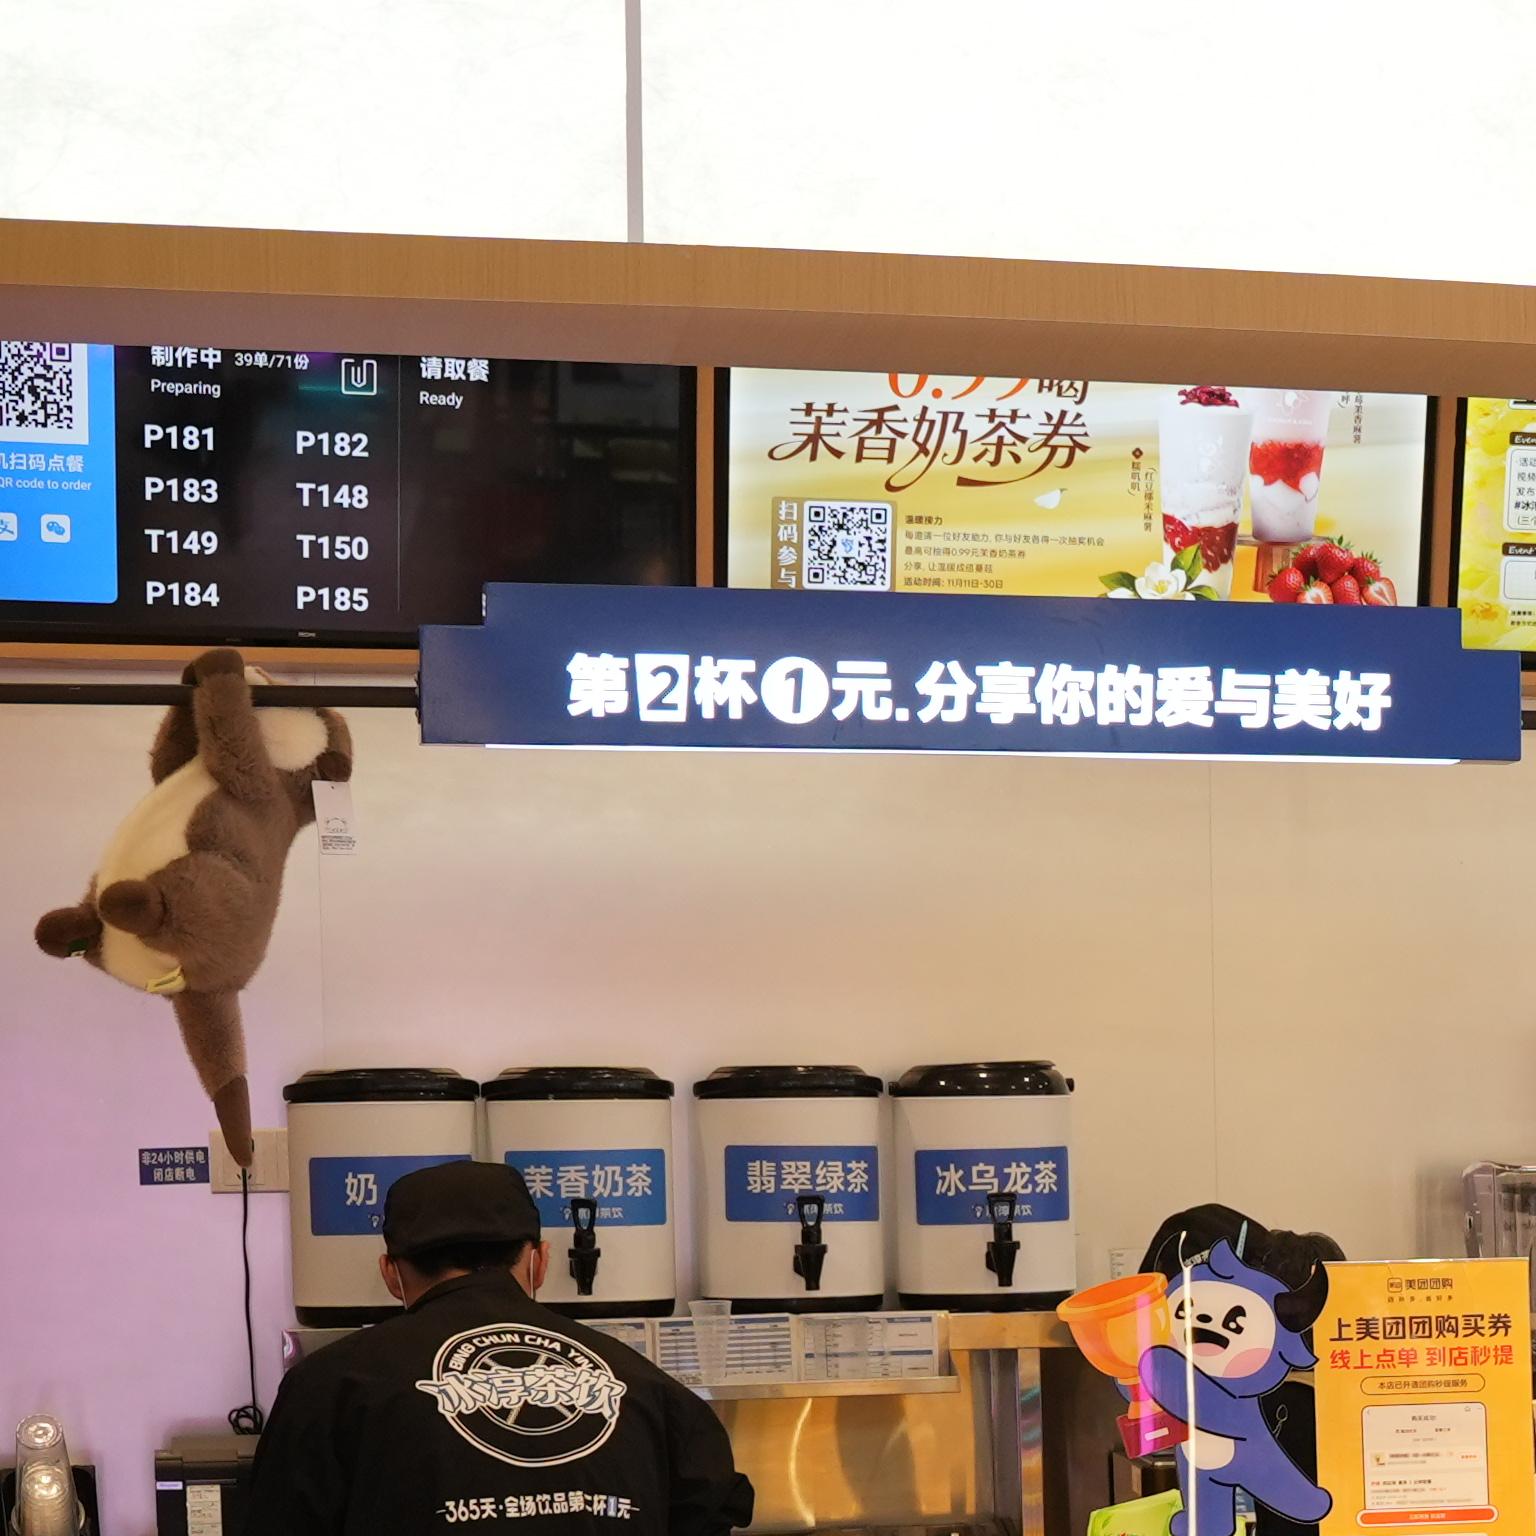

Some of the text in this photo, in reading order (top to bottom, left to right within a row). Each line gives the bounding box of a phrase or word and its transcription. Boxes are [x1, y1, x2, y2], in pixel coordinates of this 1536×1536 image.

[151, 346, 310, 370] 制作中 39单/71份
[420, 357, 489, 382] 请取餐
[150, 379, 221, 398] Preparing
[419, 391, 463, 409] Ready
[143, 424, 215, 451] P181
[296, 431, 369, 458] P182
[767, 402, 1091, 492] 茉香奶茶券
[16, 478, 44, 489] code
[47, 480, 58, 490] to
[62, 481, 91, 491] order
[144, 477, 219, 503] P183
[296, 483, 369, 509] T148
[144, 528, 219, 556] T149
[296, 534, 369, 562] T150
[777, 501, 798, 588] 扫码参与
[145, 581, 221, 607] P184
[296, 586, 369, 613] P185
[345, 1171, 378, 1207] 奶
[526, 1164, 652, 1199] 茉香奶茶
[747, 1160, 869, 1194] 翡翠绿茶
[936, 1160, 1058, 1197] 冰乌龙茶
[1329, 1312, 1513, 1342] 上美团团购买券
[449, 1341, 476, 1371] BING
[473, 1332, 521, 1349] CHUN
[524, 1333, 562, 1352] CHA
[1330, 1344, 1514, 1370] 线上点单 到店秒提
[415, 1364, 627, 1423] 冰淳茶饮
